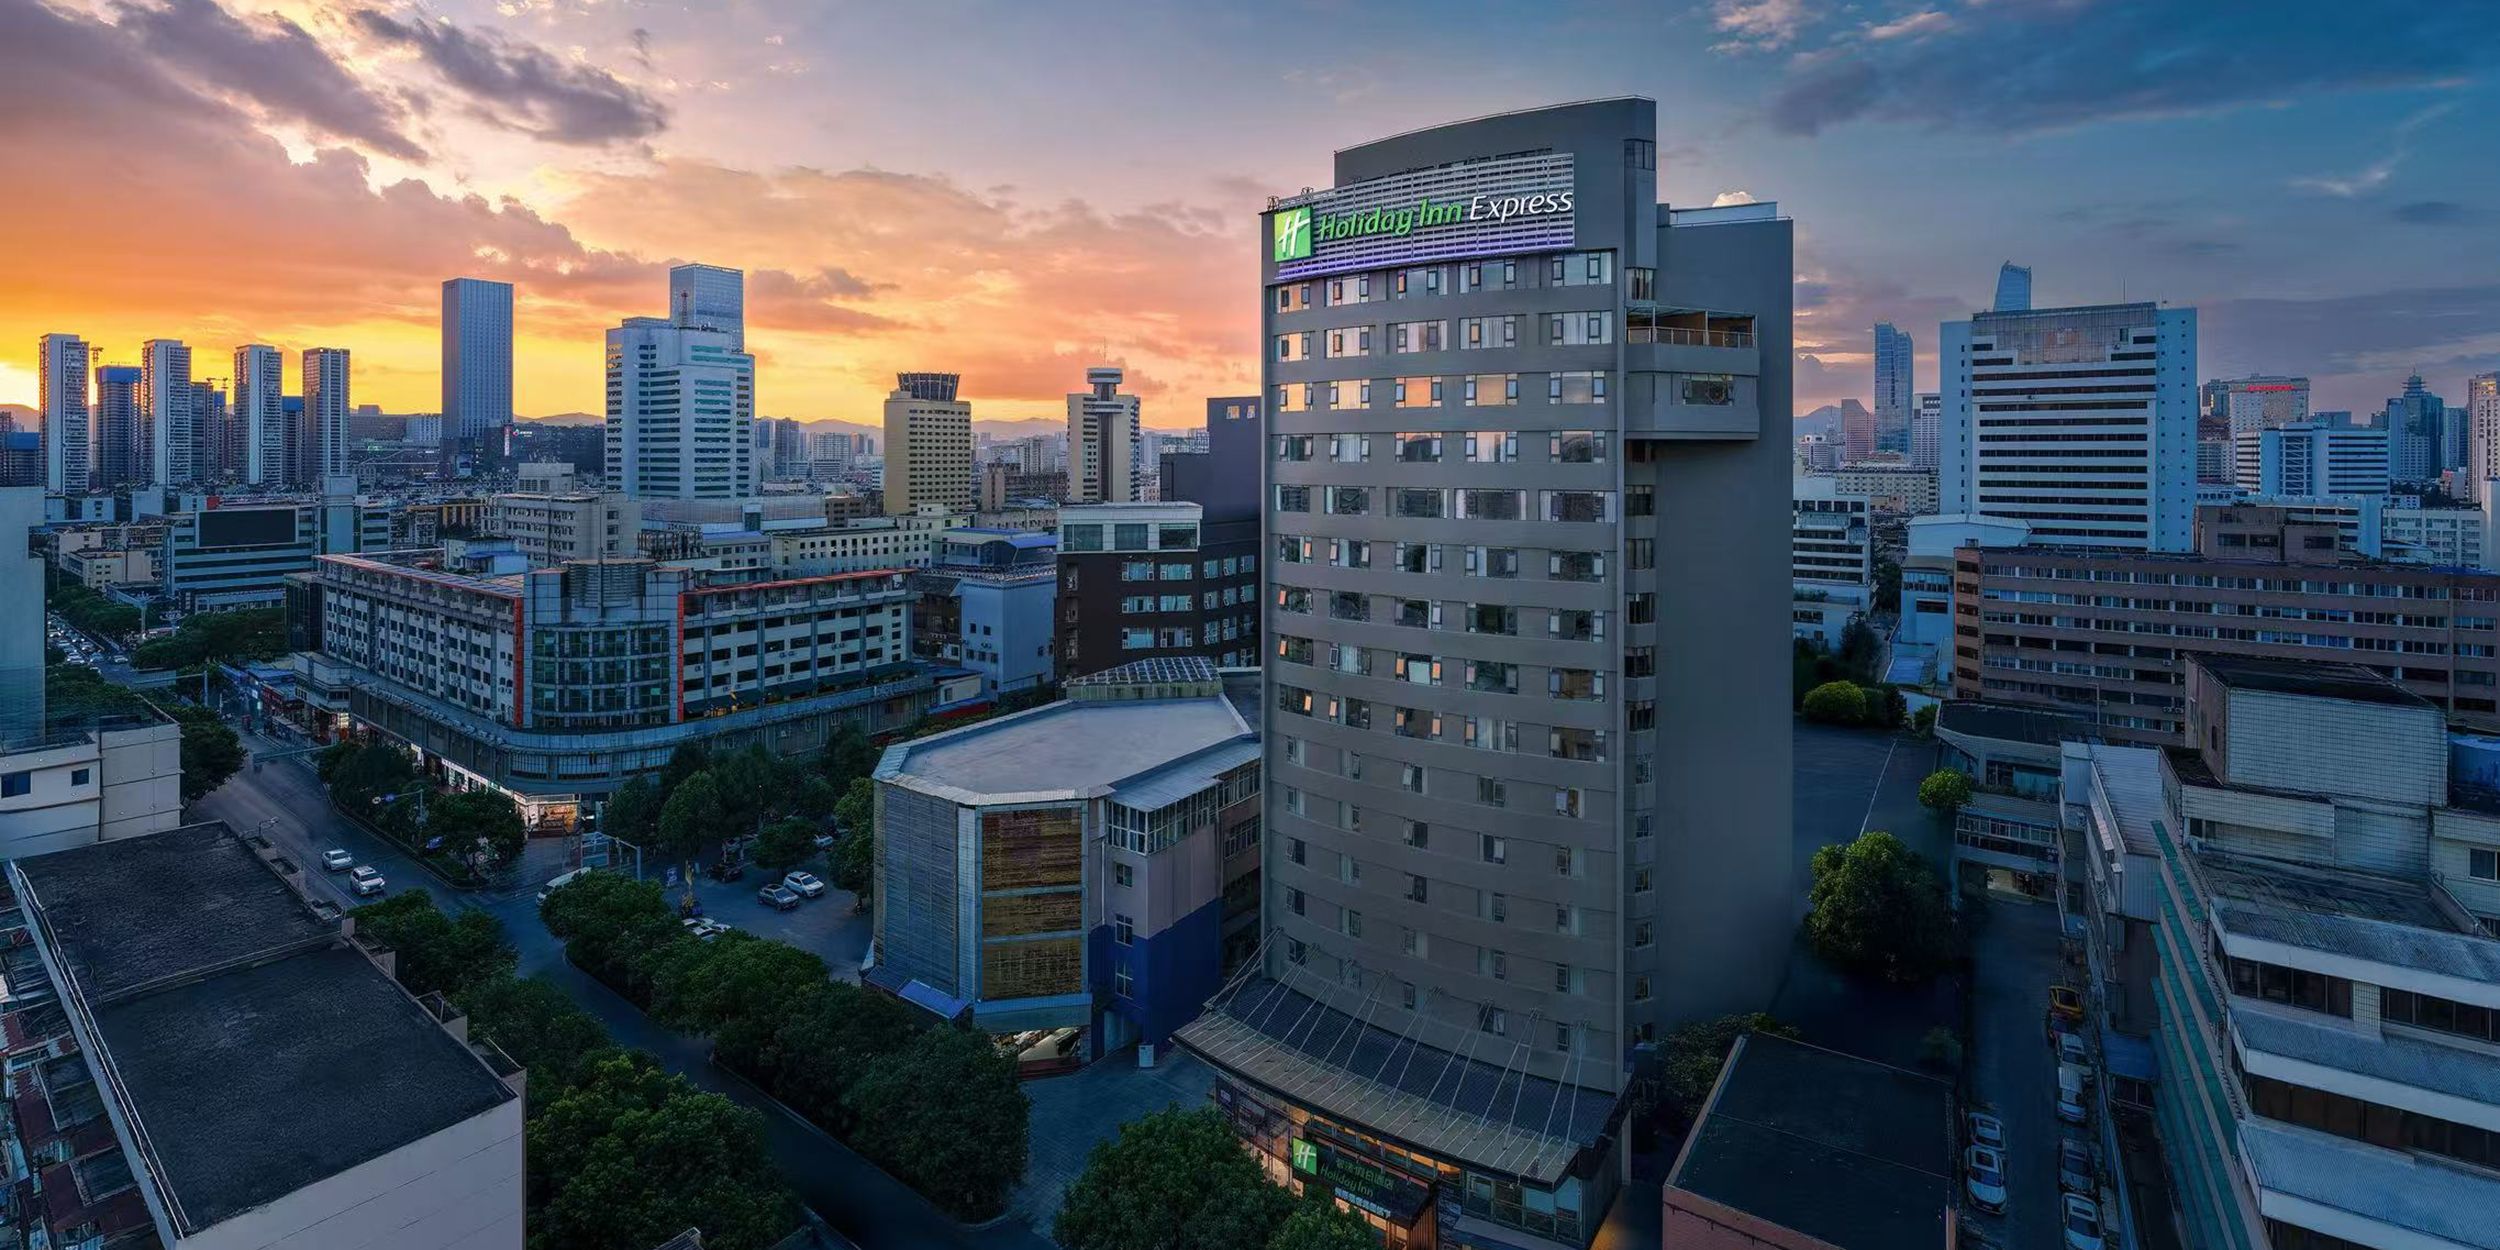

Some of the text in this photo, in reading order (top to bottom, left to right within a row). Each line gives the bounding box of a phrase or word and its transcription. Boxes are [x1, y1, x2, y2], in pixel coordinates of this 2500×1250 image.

[1319, 192, 1574, 240] Holiday Inn Express
[1320, 1162, 1374, 1197] Holiday Inn
